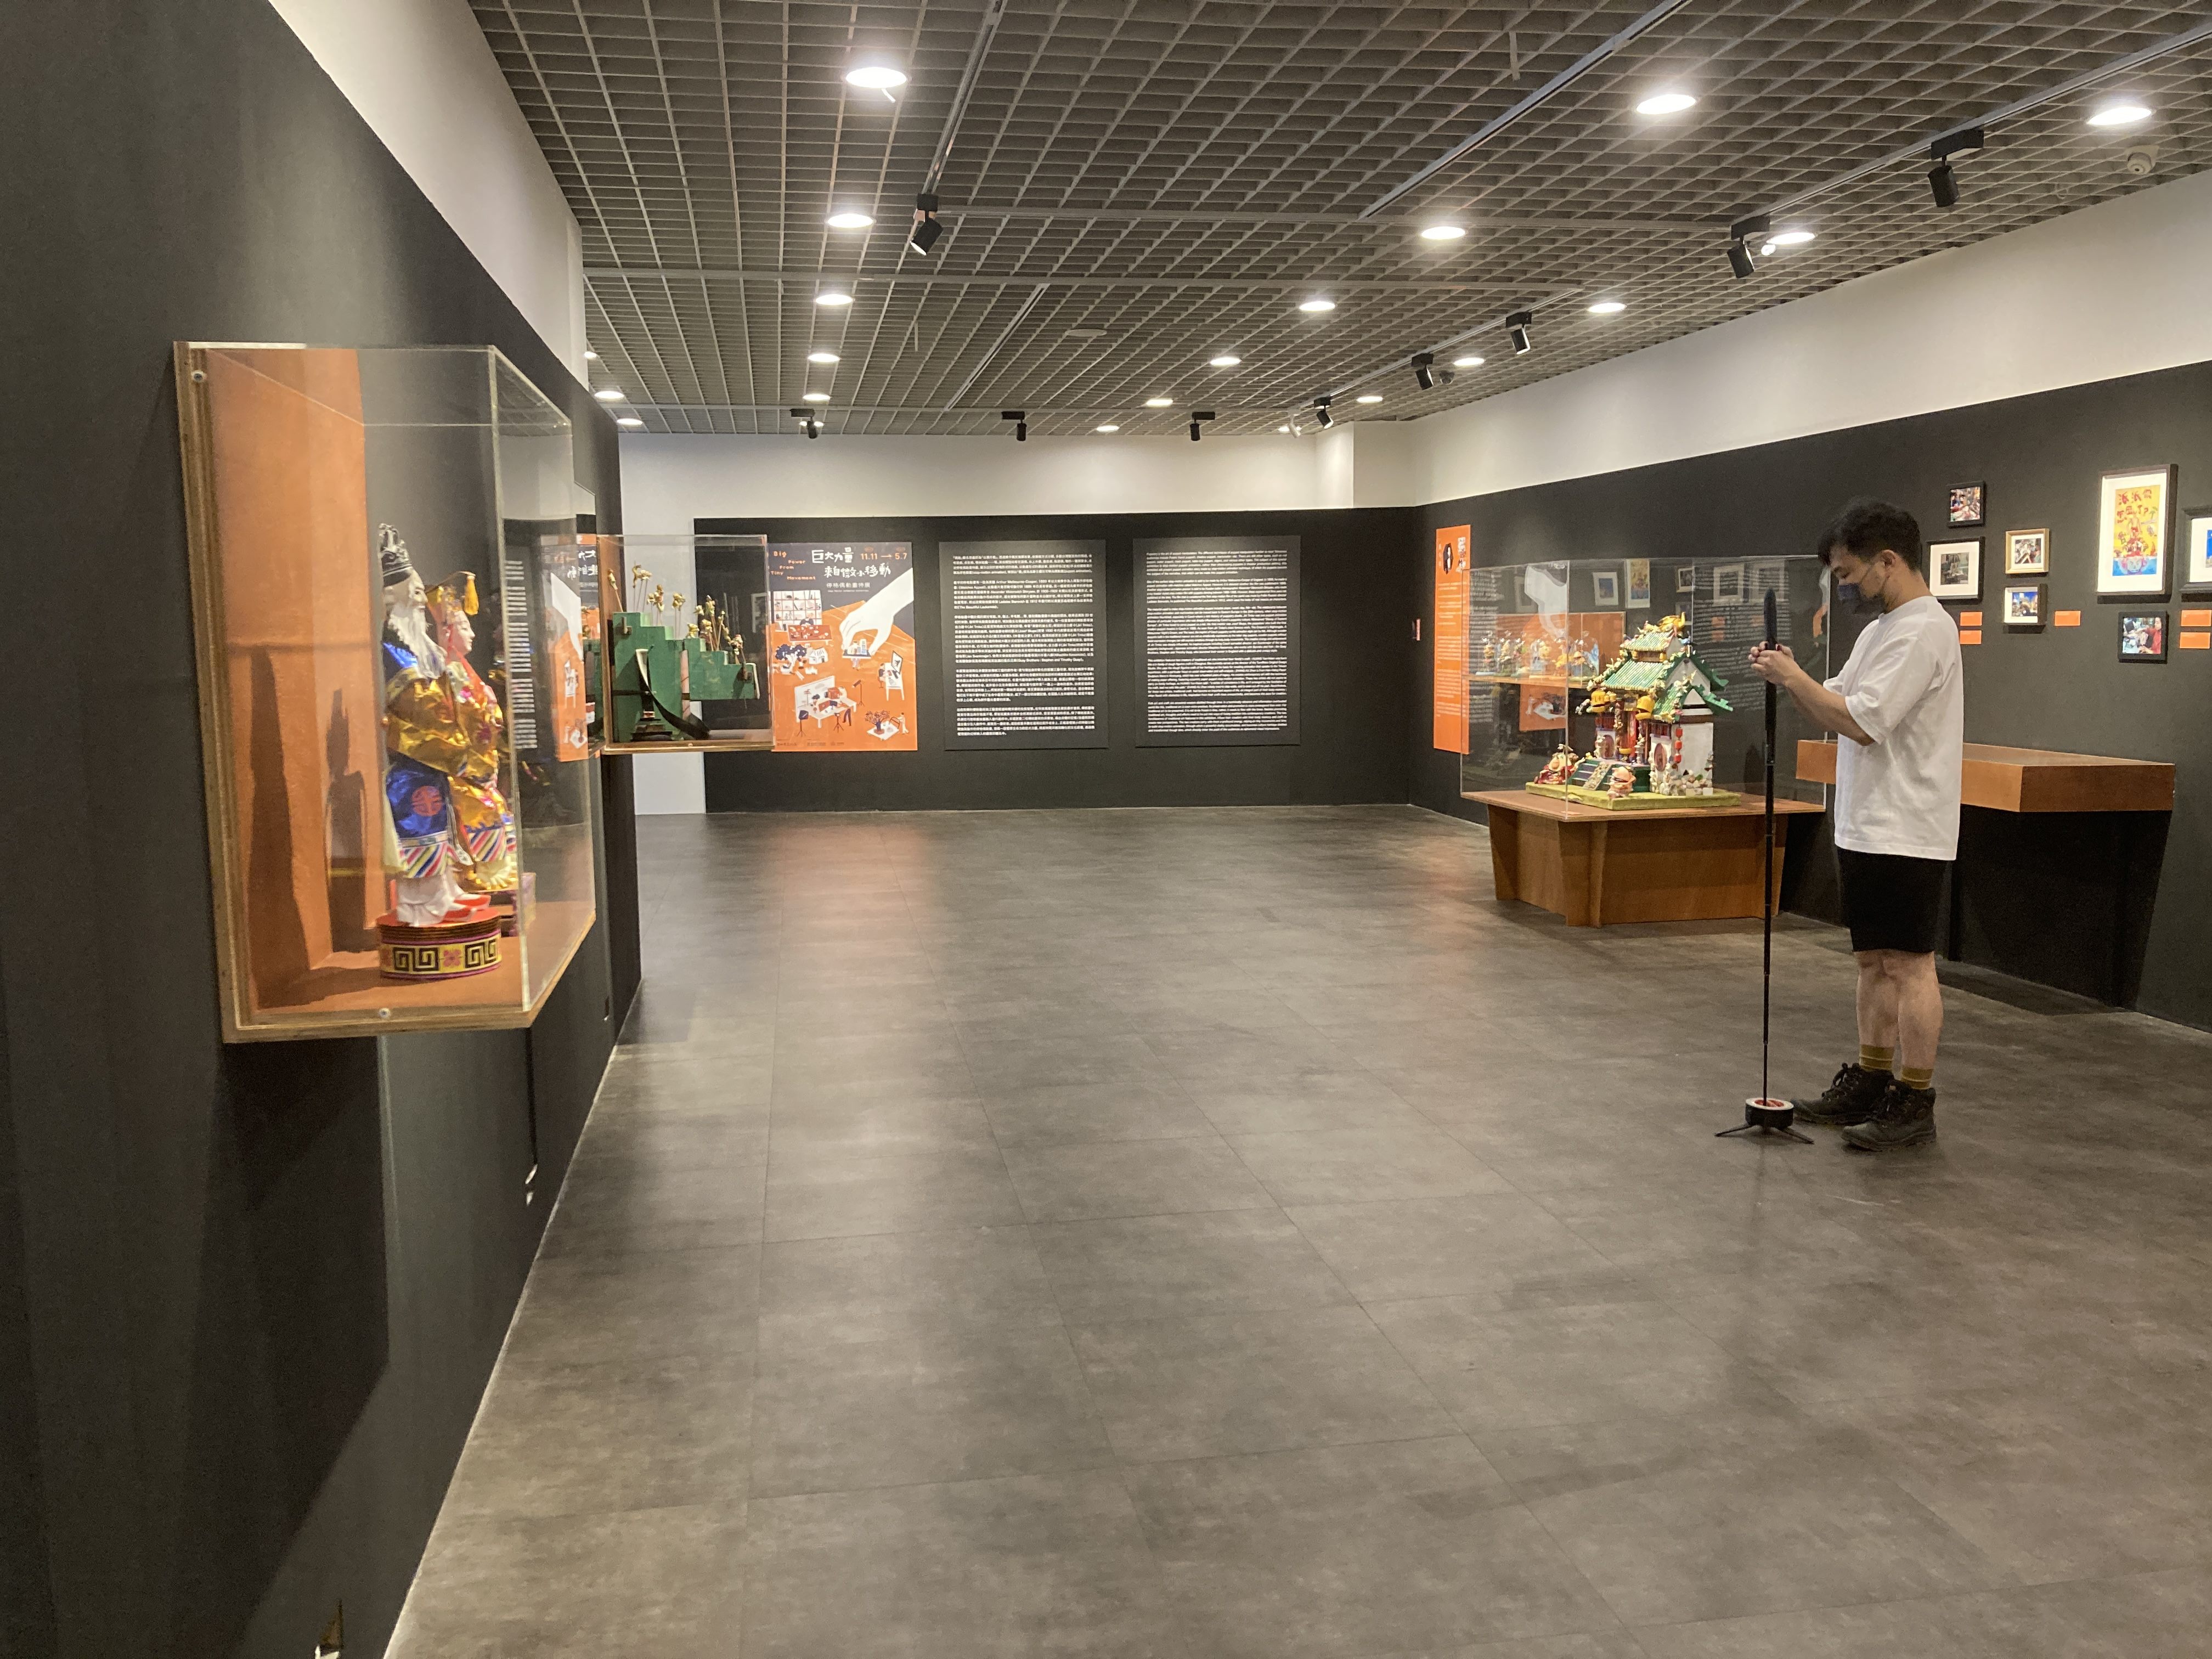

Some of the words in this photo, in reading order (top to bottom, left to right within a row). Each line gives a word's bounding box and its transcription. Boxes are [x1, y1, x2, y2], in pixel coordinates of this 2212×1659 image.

[811, 547, 854, 563] 巨大力量
[823, 562, 891, 578] 來自微小移動
